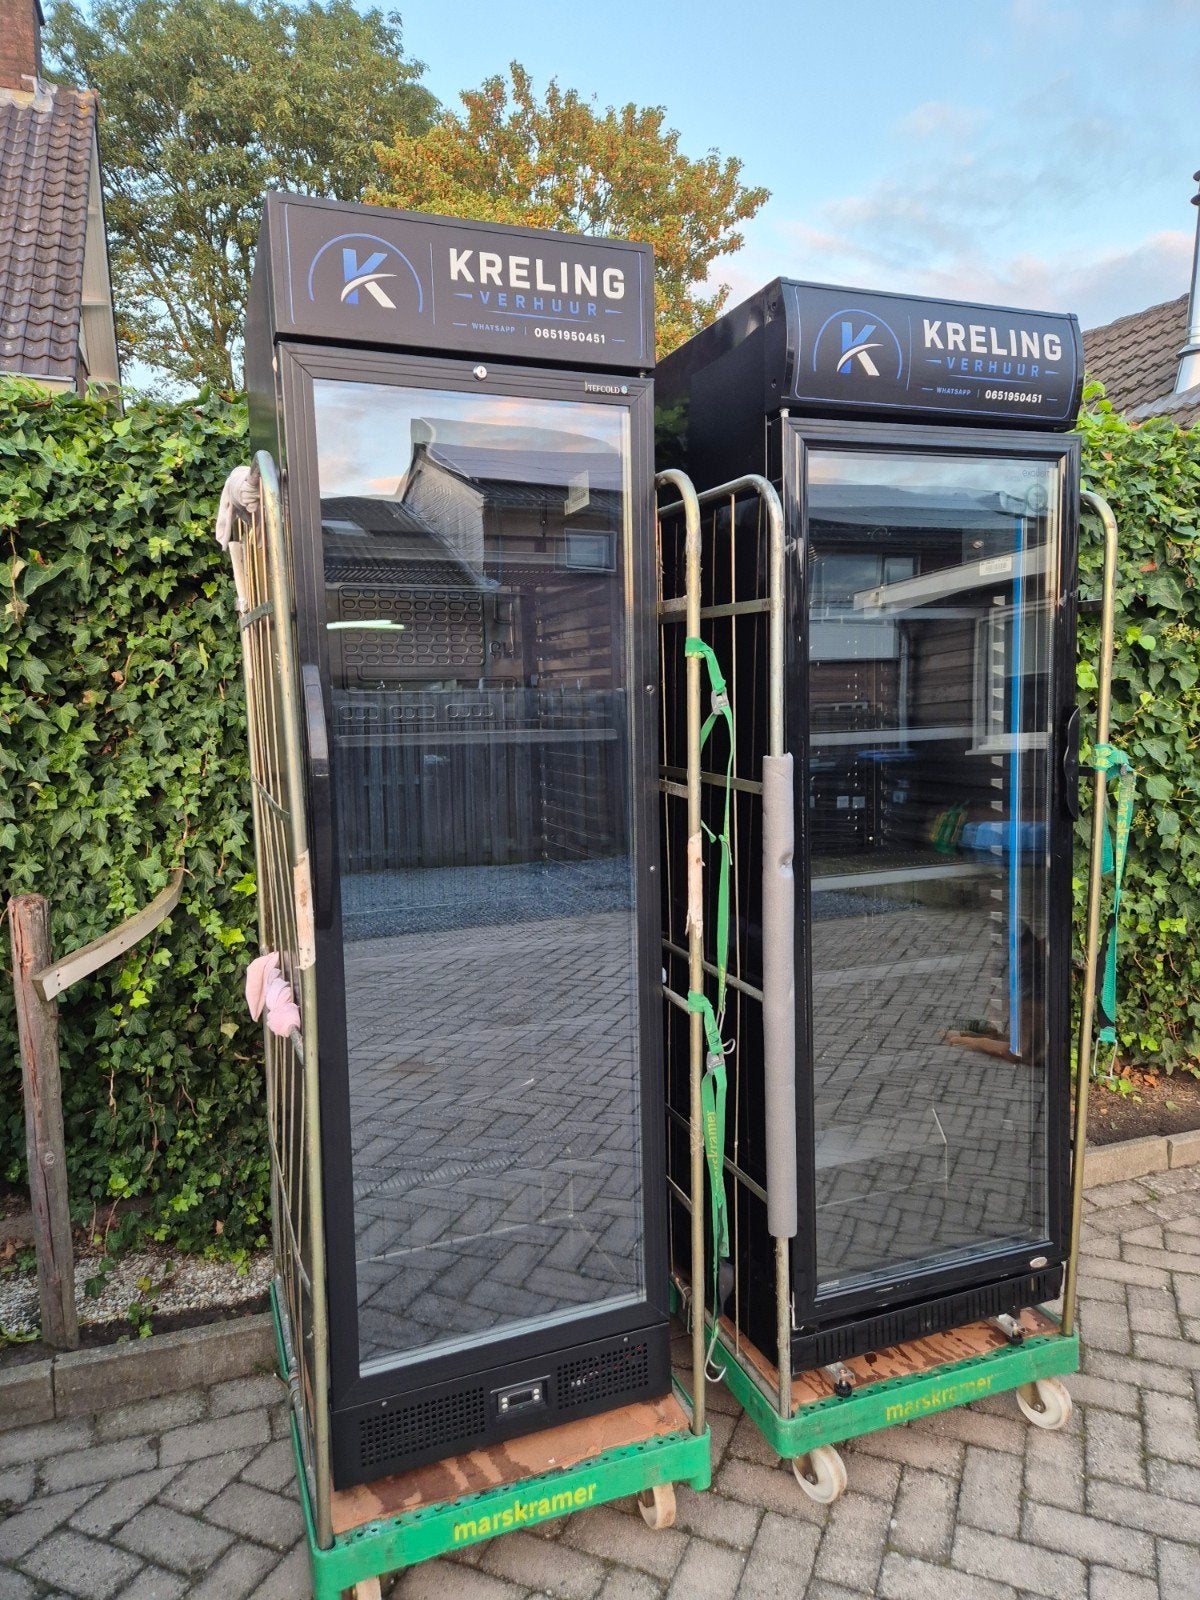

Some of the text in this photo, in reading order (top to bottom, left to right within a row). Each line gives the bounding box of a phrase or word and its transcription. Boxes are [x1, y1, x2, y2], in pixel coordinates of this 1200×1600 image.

[449, 247, 625, 300] KRELING
[479, 291, 598, 316] VERHUUR
[471, 322, 606, 344] WHATSAPP 0651950451
[923, 319, 1062, 361] KRELING
[946, 356, 1040, 377] VERHUUR
[587, 384, 620, 394] TEFCOLD
[936, 386, 1042, 403] WHATSAPP 0651950451
[453, 1482, 597, 1541] marskramer
